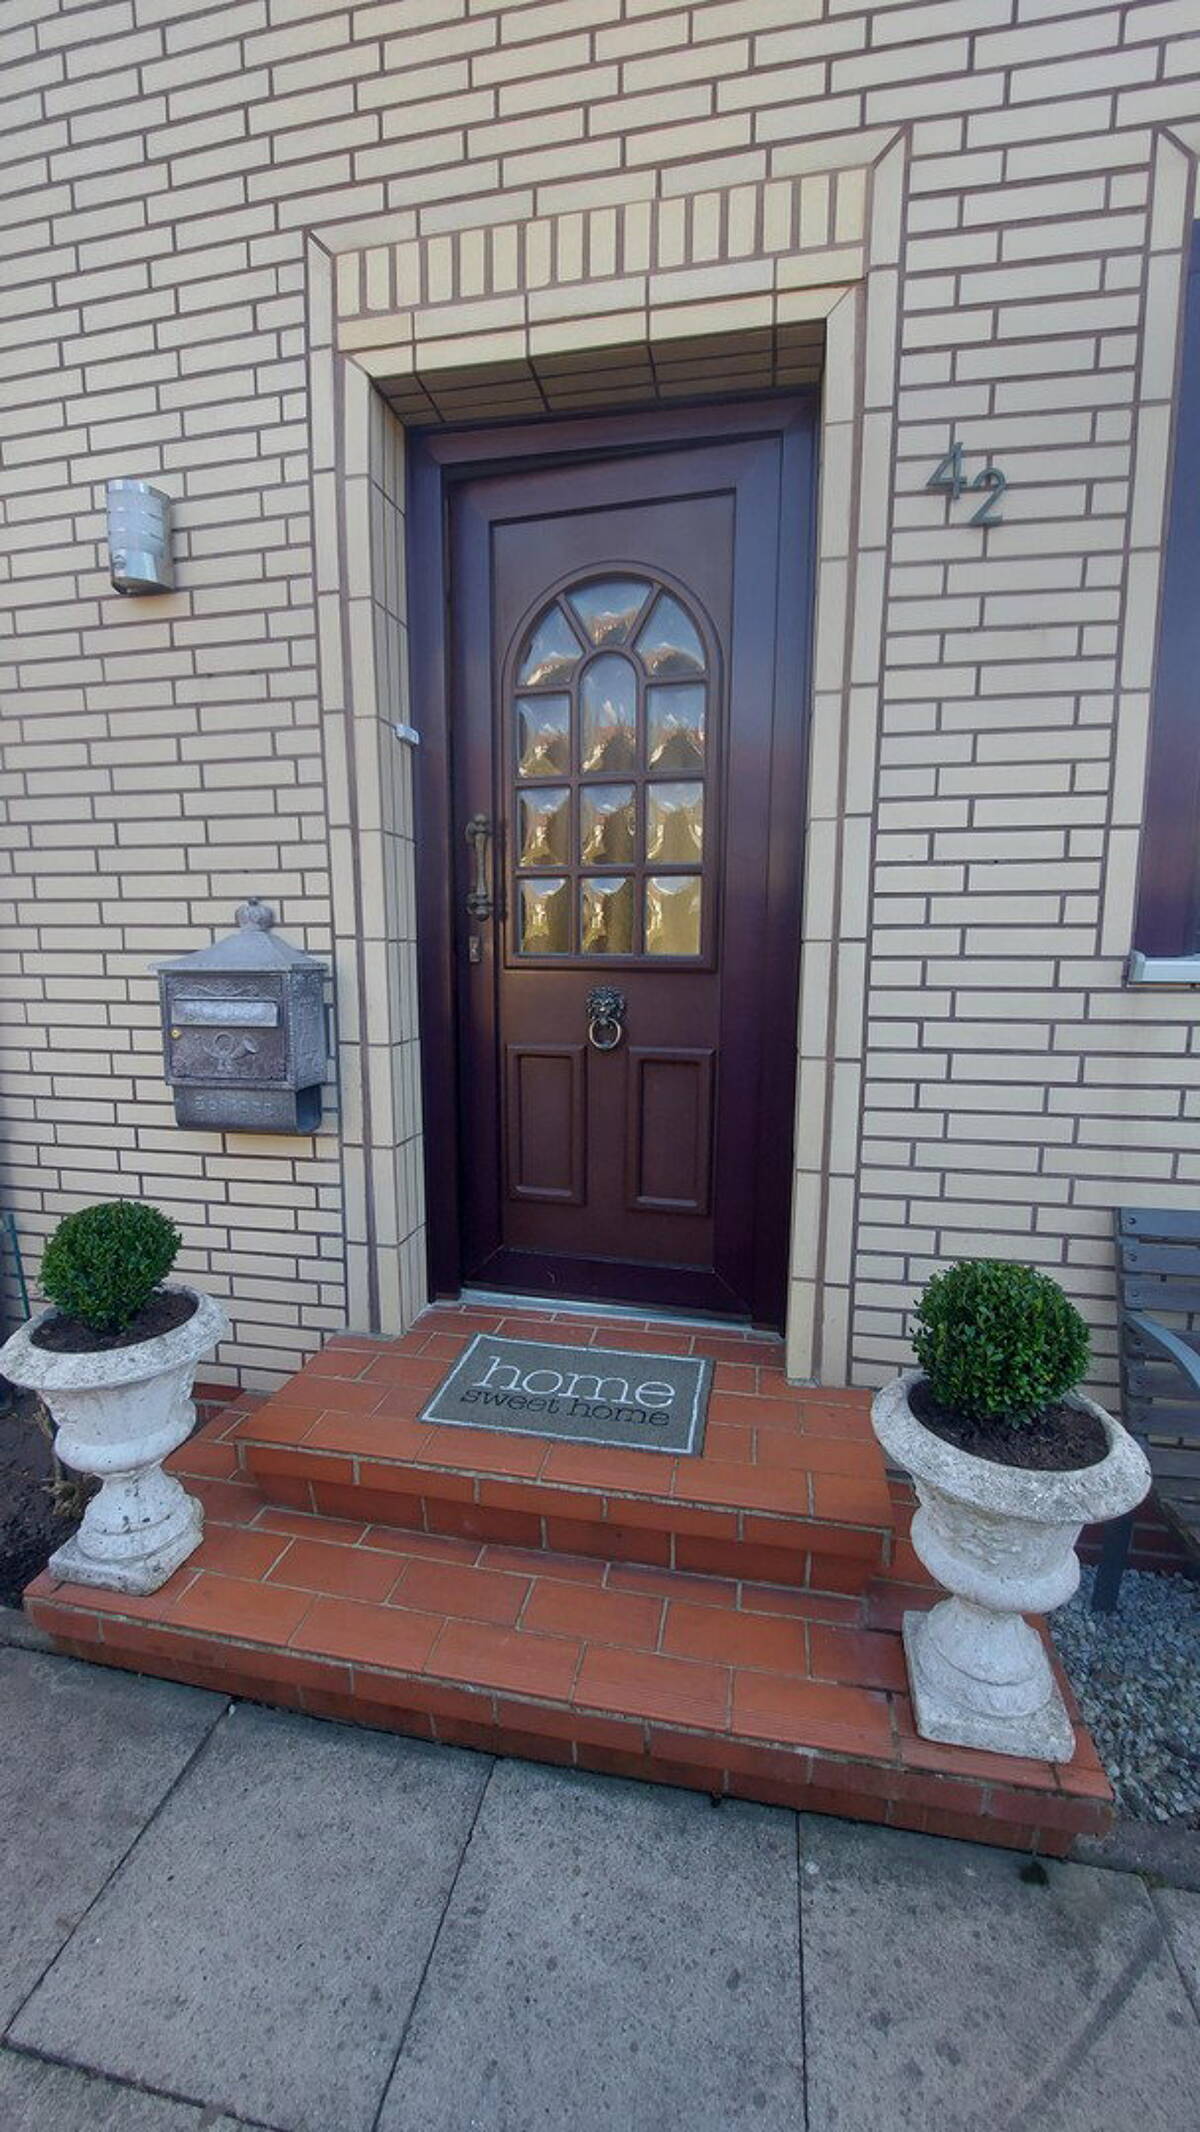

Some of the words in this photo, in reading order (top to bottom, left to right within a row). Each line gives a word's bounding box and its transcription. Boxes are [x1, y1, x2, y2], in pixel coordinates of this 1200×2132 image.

[926, 442, 1007, 527] 42
[459, 1388, 560, 1416] sweet
[565, 1397, 671, 1426] home
[472, 1355, 676, 1408] home
